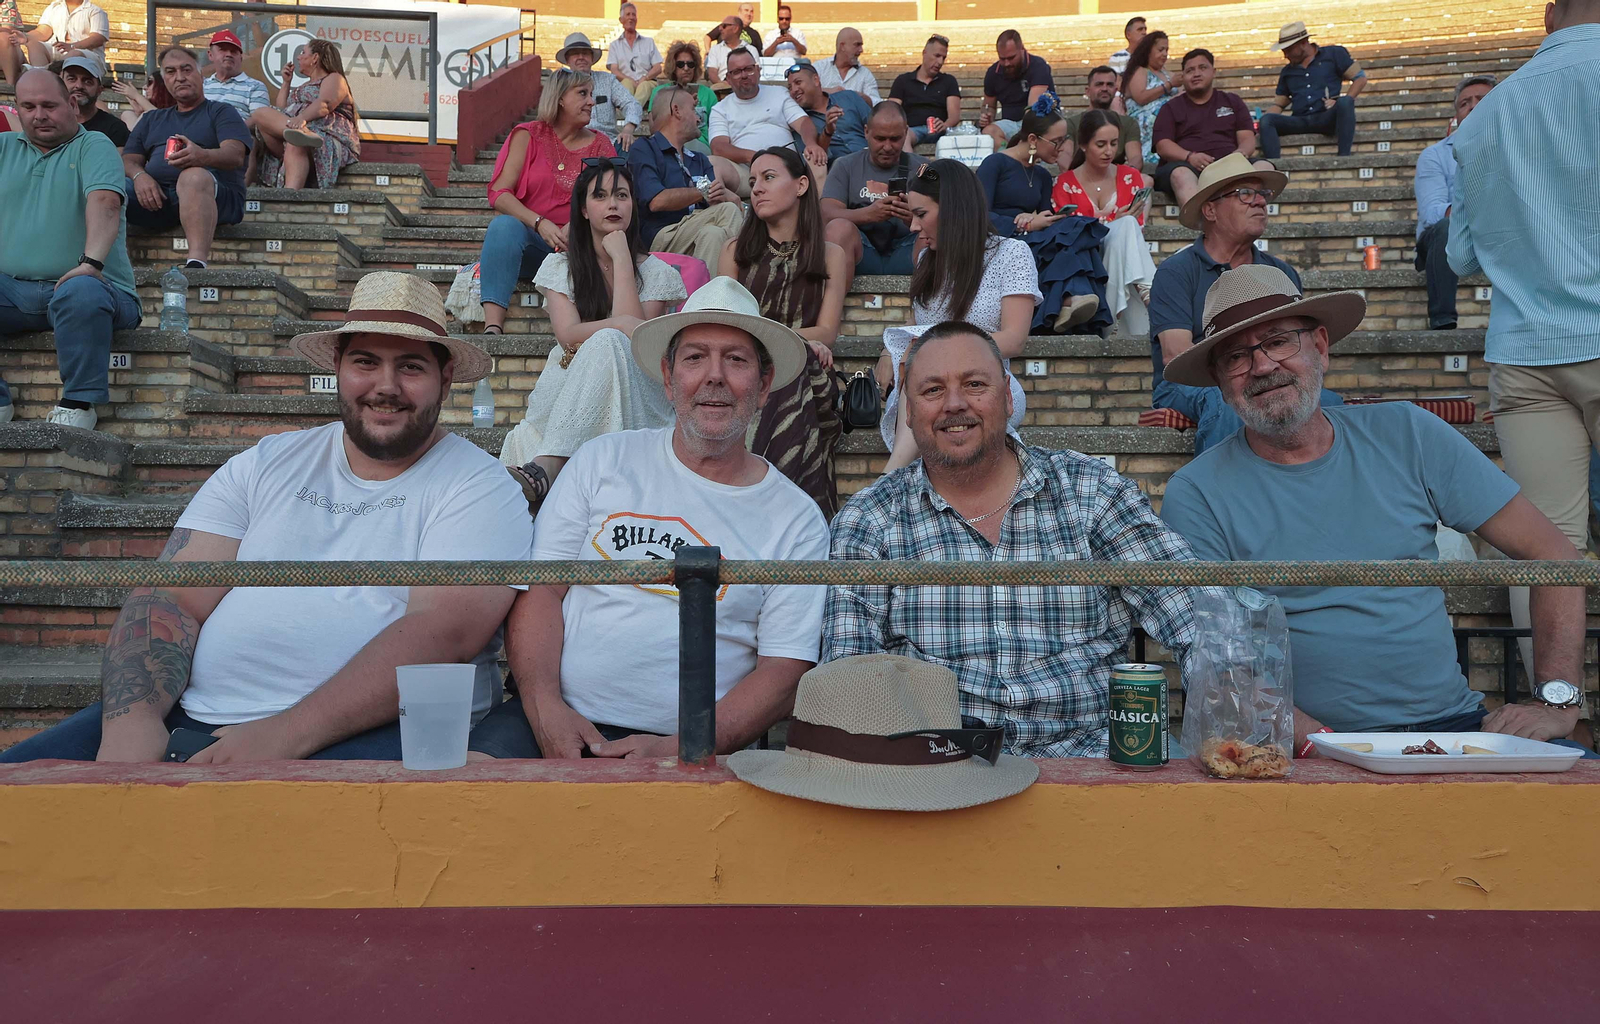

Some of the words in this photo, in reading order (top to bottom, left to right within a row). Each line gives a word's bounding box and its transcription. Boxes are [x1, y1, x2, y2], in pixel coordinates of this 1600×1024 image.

[1362, 169, 1371, 177] 11
[248, 202, 259, 210] 33
[1355, 202, 1366, 211] 10
[176, 239, 187, 248] 31
[268, 241, 280, 250] 32
[203, 288, 215, 299] 32
[1482, 288, 1488, 298] 9
[112, 355, 127, 367] 30
[1453, 357, 1460, 368] 8
[1033, 361, 1040, 373] 5
[612, 524, 690, 553] BILLAB
[1109, 709, 1160, 724] CLÁSICA
